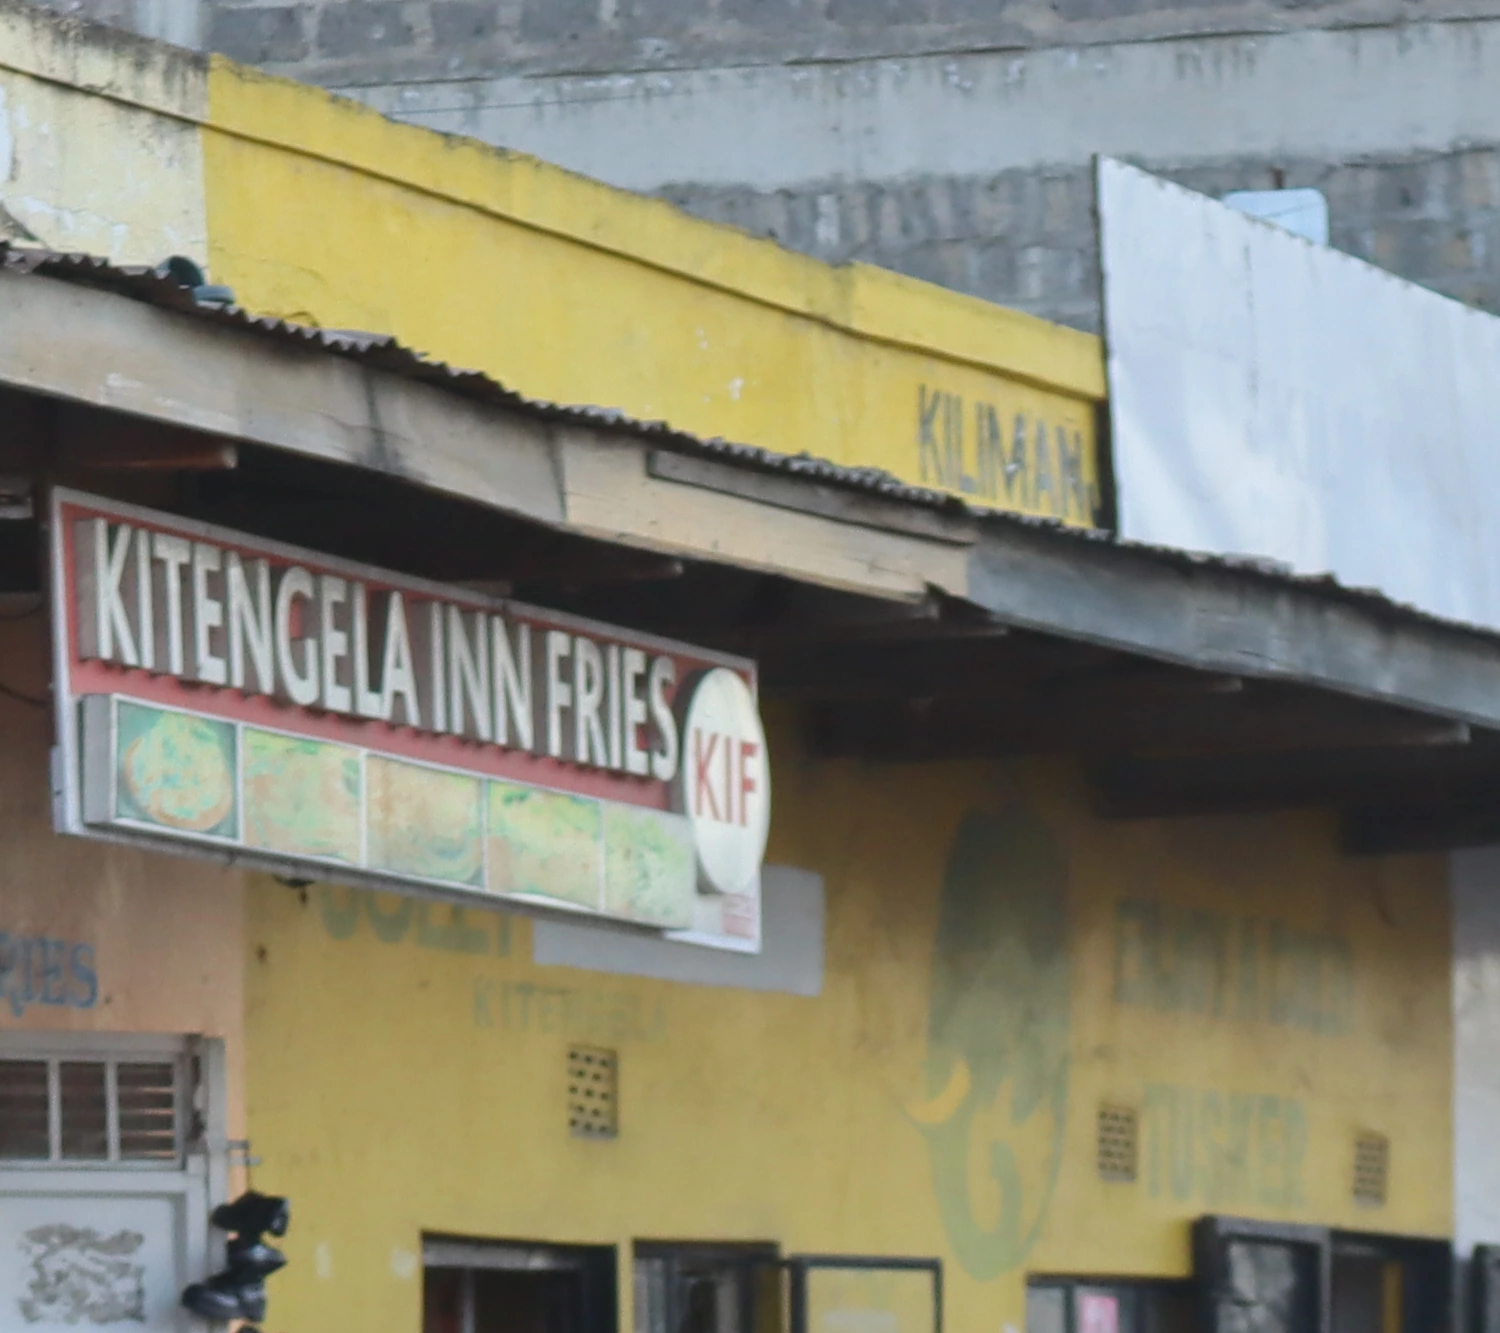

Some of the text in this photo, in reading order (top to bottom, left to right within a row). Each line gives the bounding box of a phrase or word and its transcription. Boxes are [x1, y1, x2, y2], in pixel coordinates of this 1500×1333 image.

[94, 517, 678, 782] KITENGELA INN FRIES
[697, 729, 760, 829] KIF
